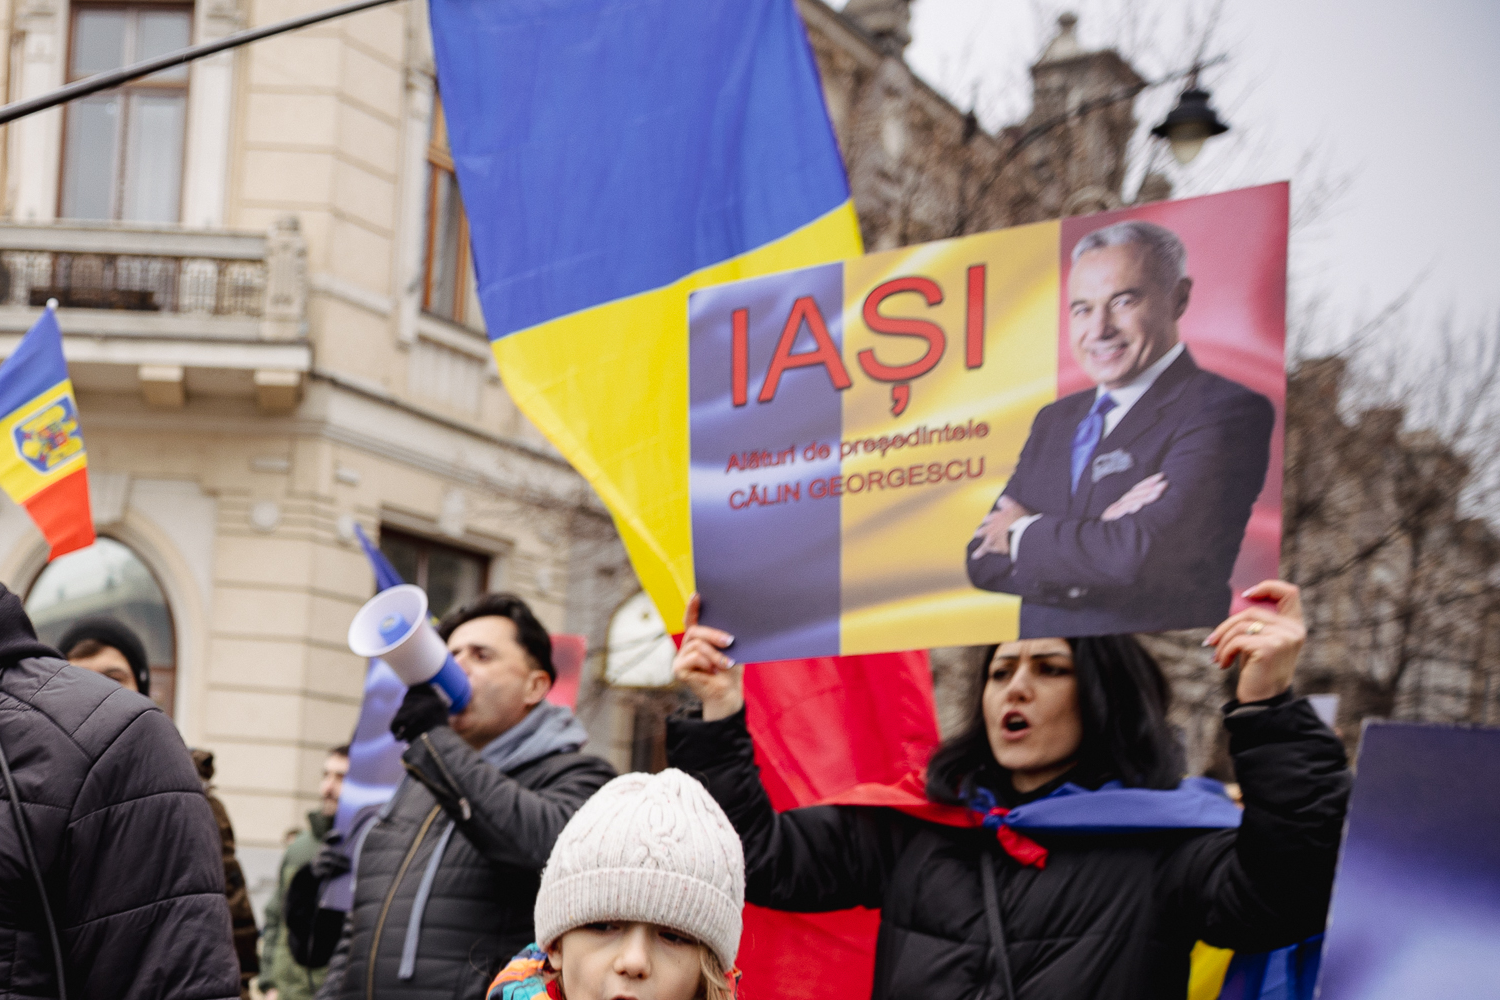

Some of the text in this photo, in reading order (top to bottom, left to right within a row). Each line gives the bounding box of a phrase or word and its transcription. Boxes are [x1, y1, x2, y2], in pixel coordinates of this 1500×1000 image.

[730, 264, 988, 416] IAȘI
[726, 420, 989, 473] Alături de președintele
[729, 456, 986, 511] CĂLIN GEORGESCU
